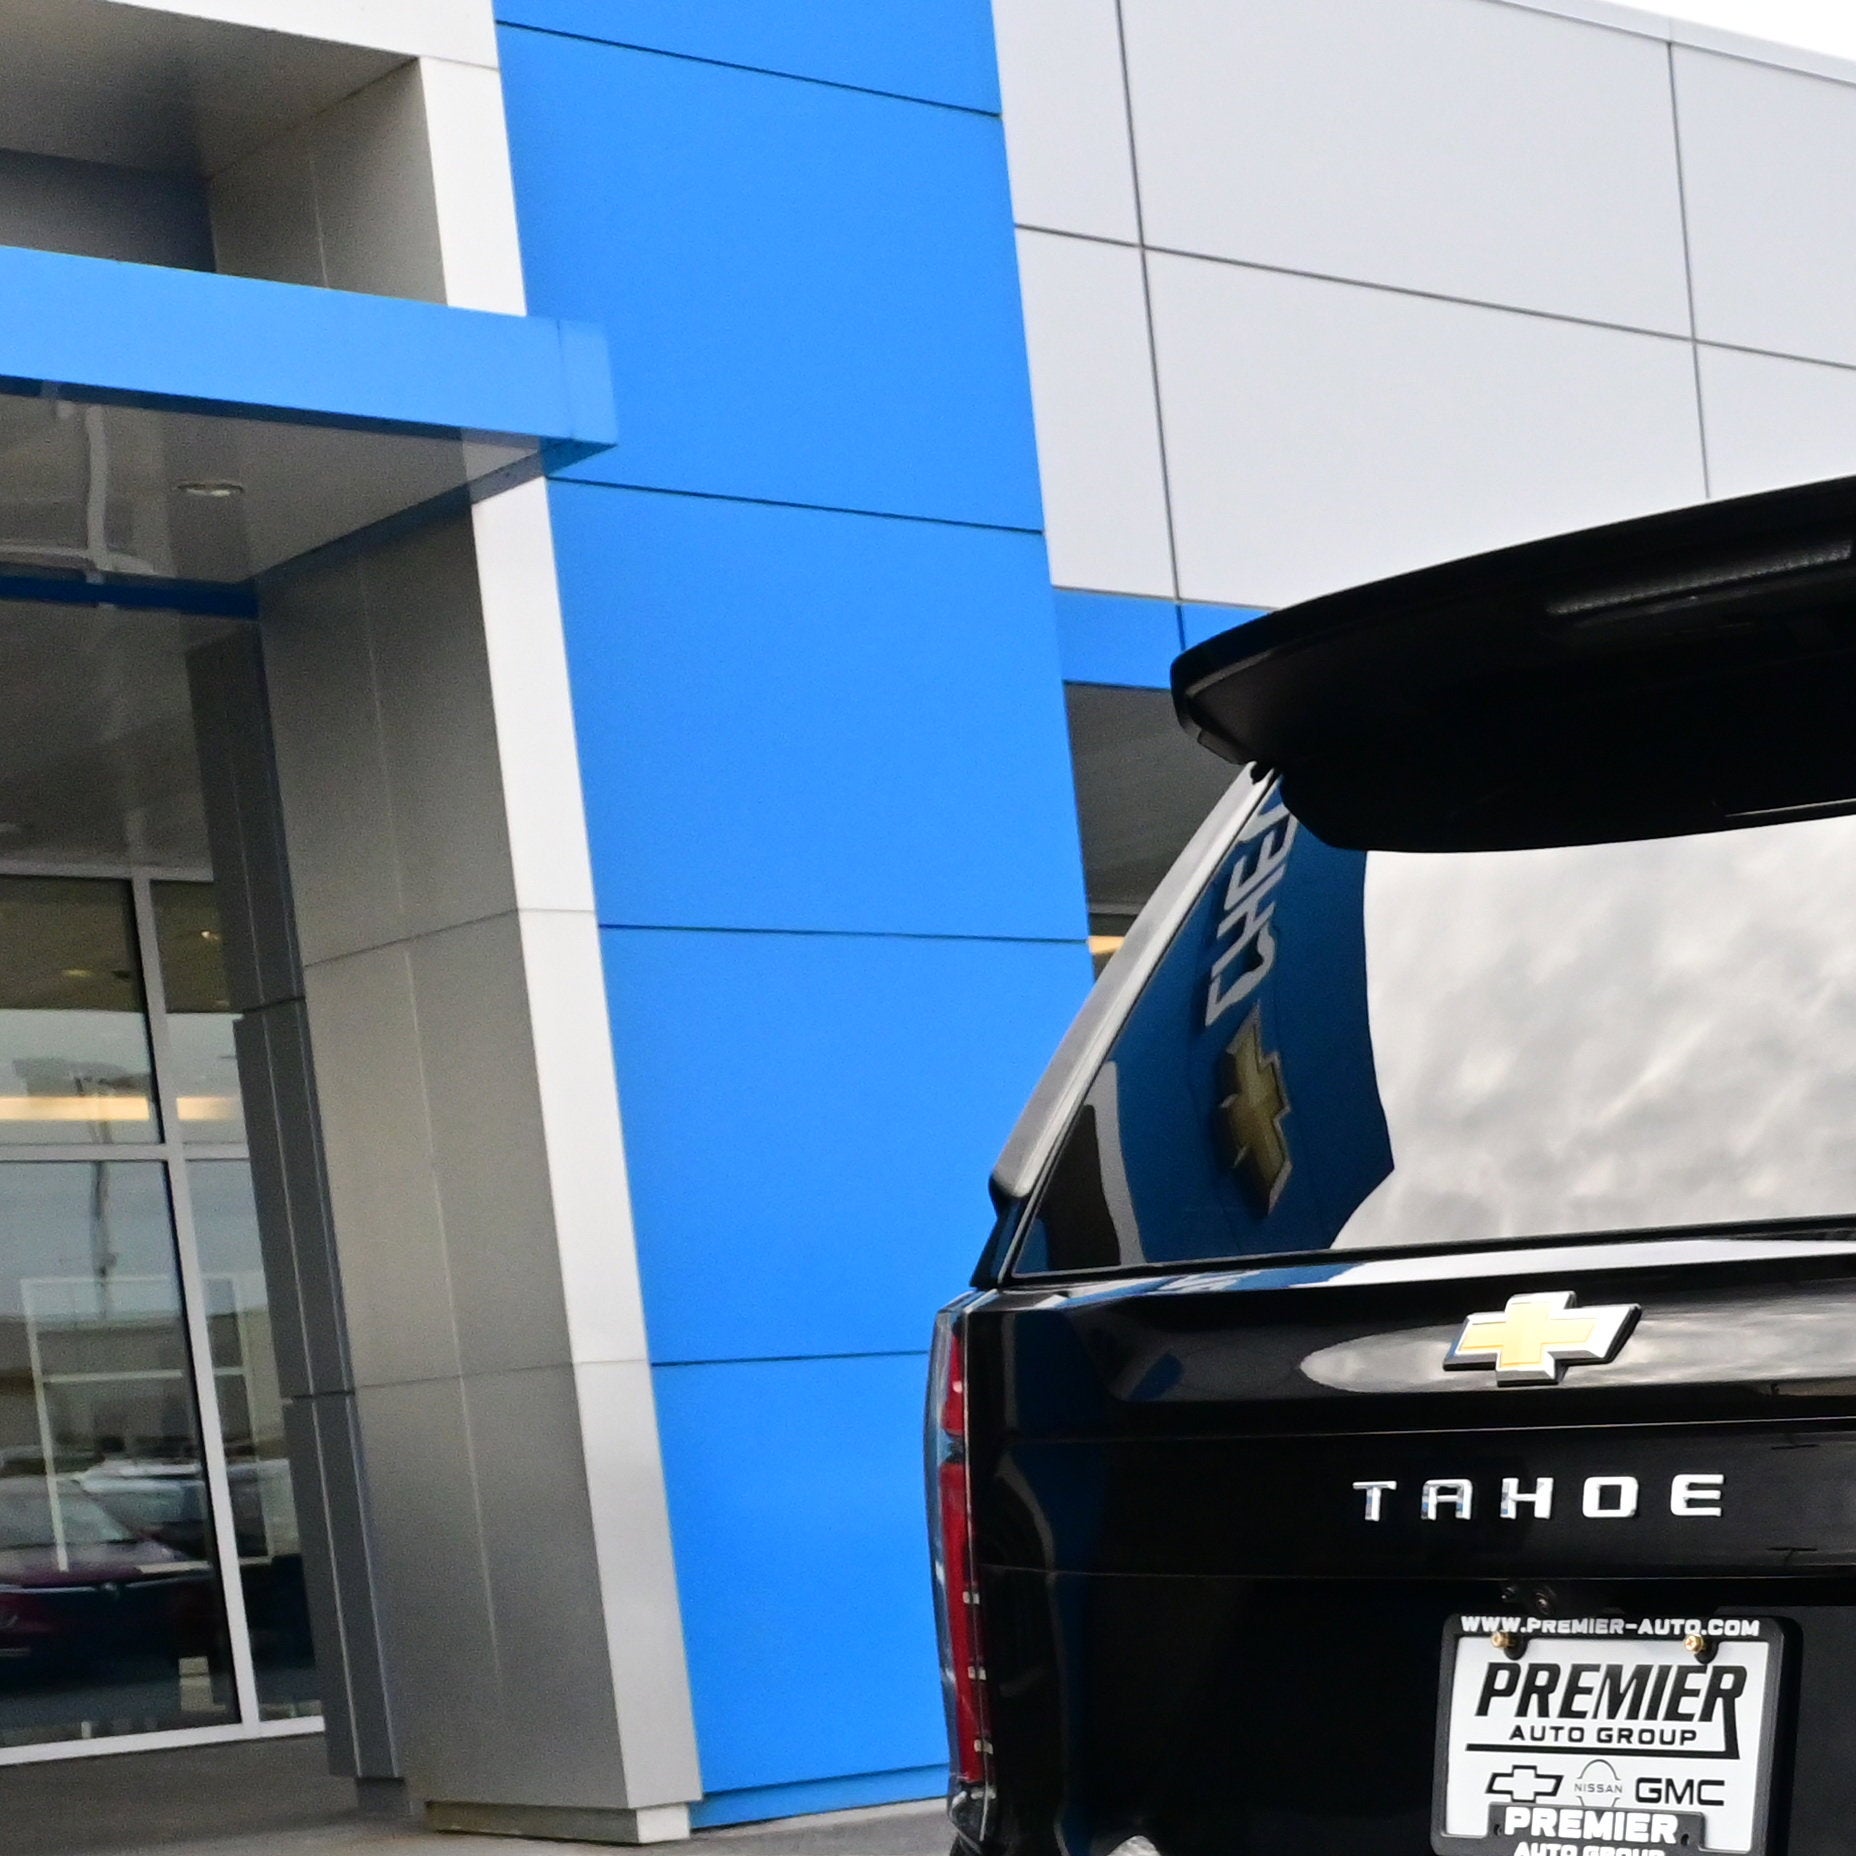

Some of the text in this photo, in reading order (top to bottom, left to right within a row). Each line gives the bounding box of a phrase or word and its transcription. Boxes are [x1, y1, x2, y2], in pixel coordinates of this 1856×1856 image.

[1353, 1474, 1725, 1521] TAHOE
[1461, 1615, 1759, 1636] WWW.PREMIER-AUTO.COM
[1474, 1662, 1748, 1723] PREMIER
[1509, 1725, 1697, 1746] AUTO GROUP
[1574, 1783, 1623, 1793] NISSAN
[1635, 1777, 1725, 1806] GMC
[1504, 1806, 1679, 1844] PREMIER
